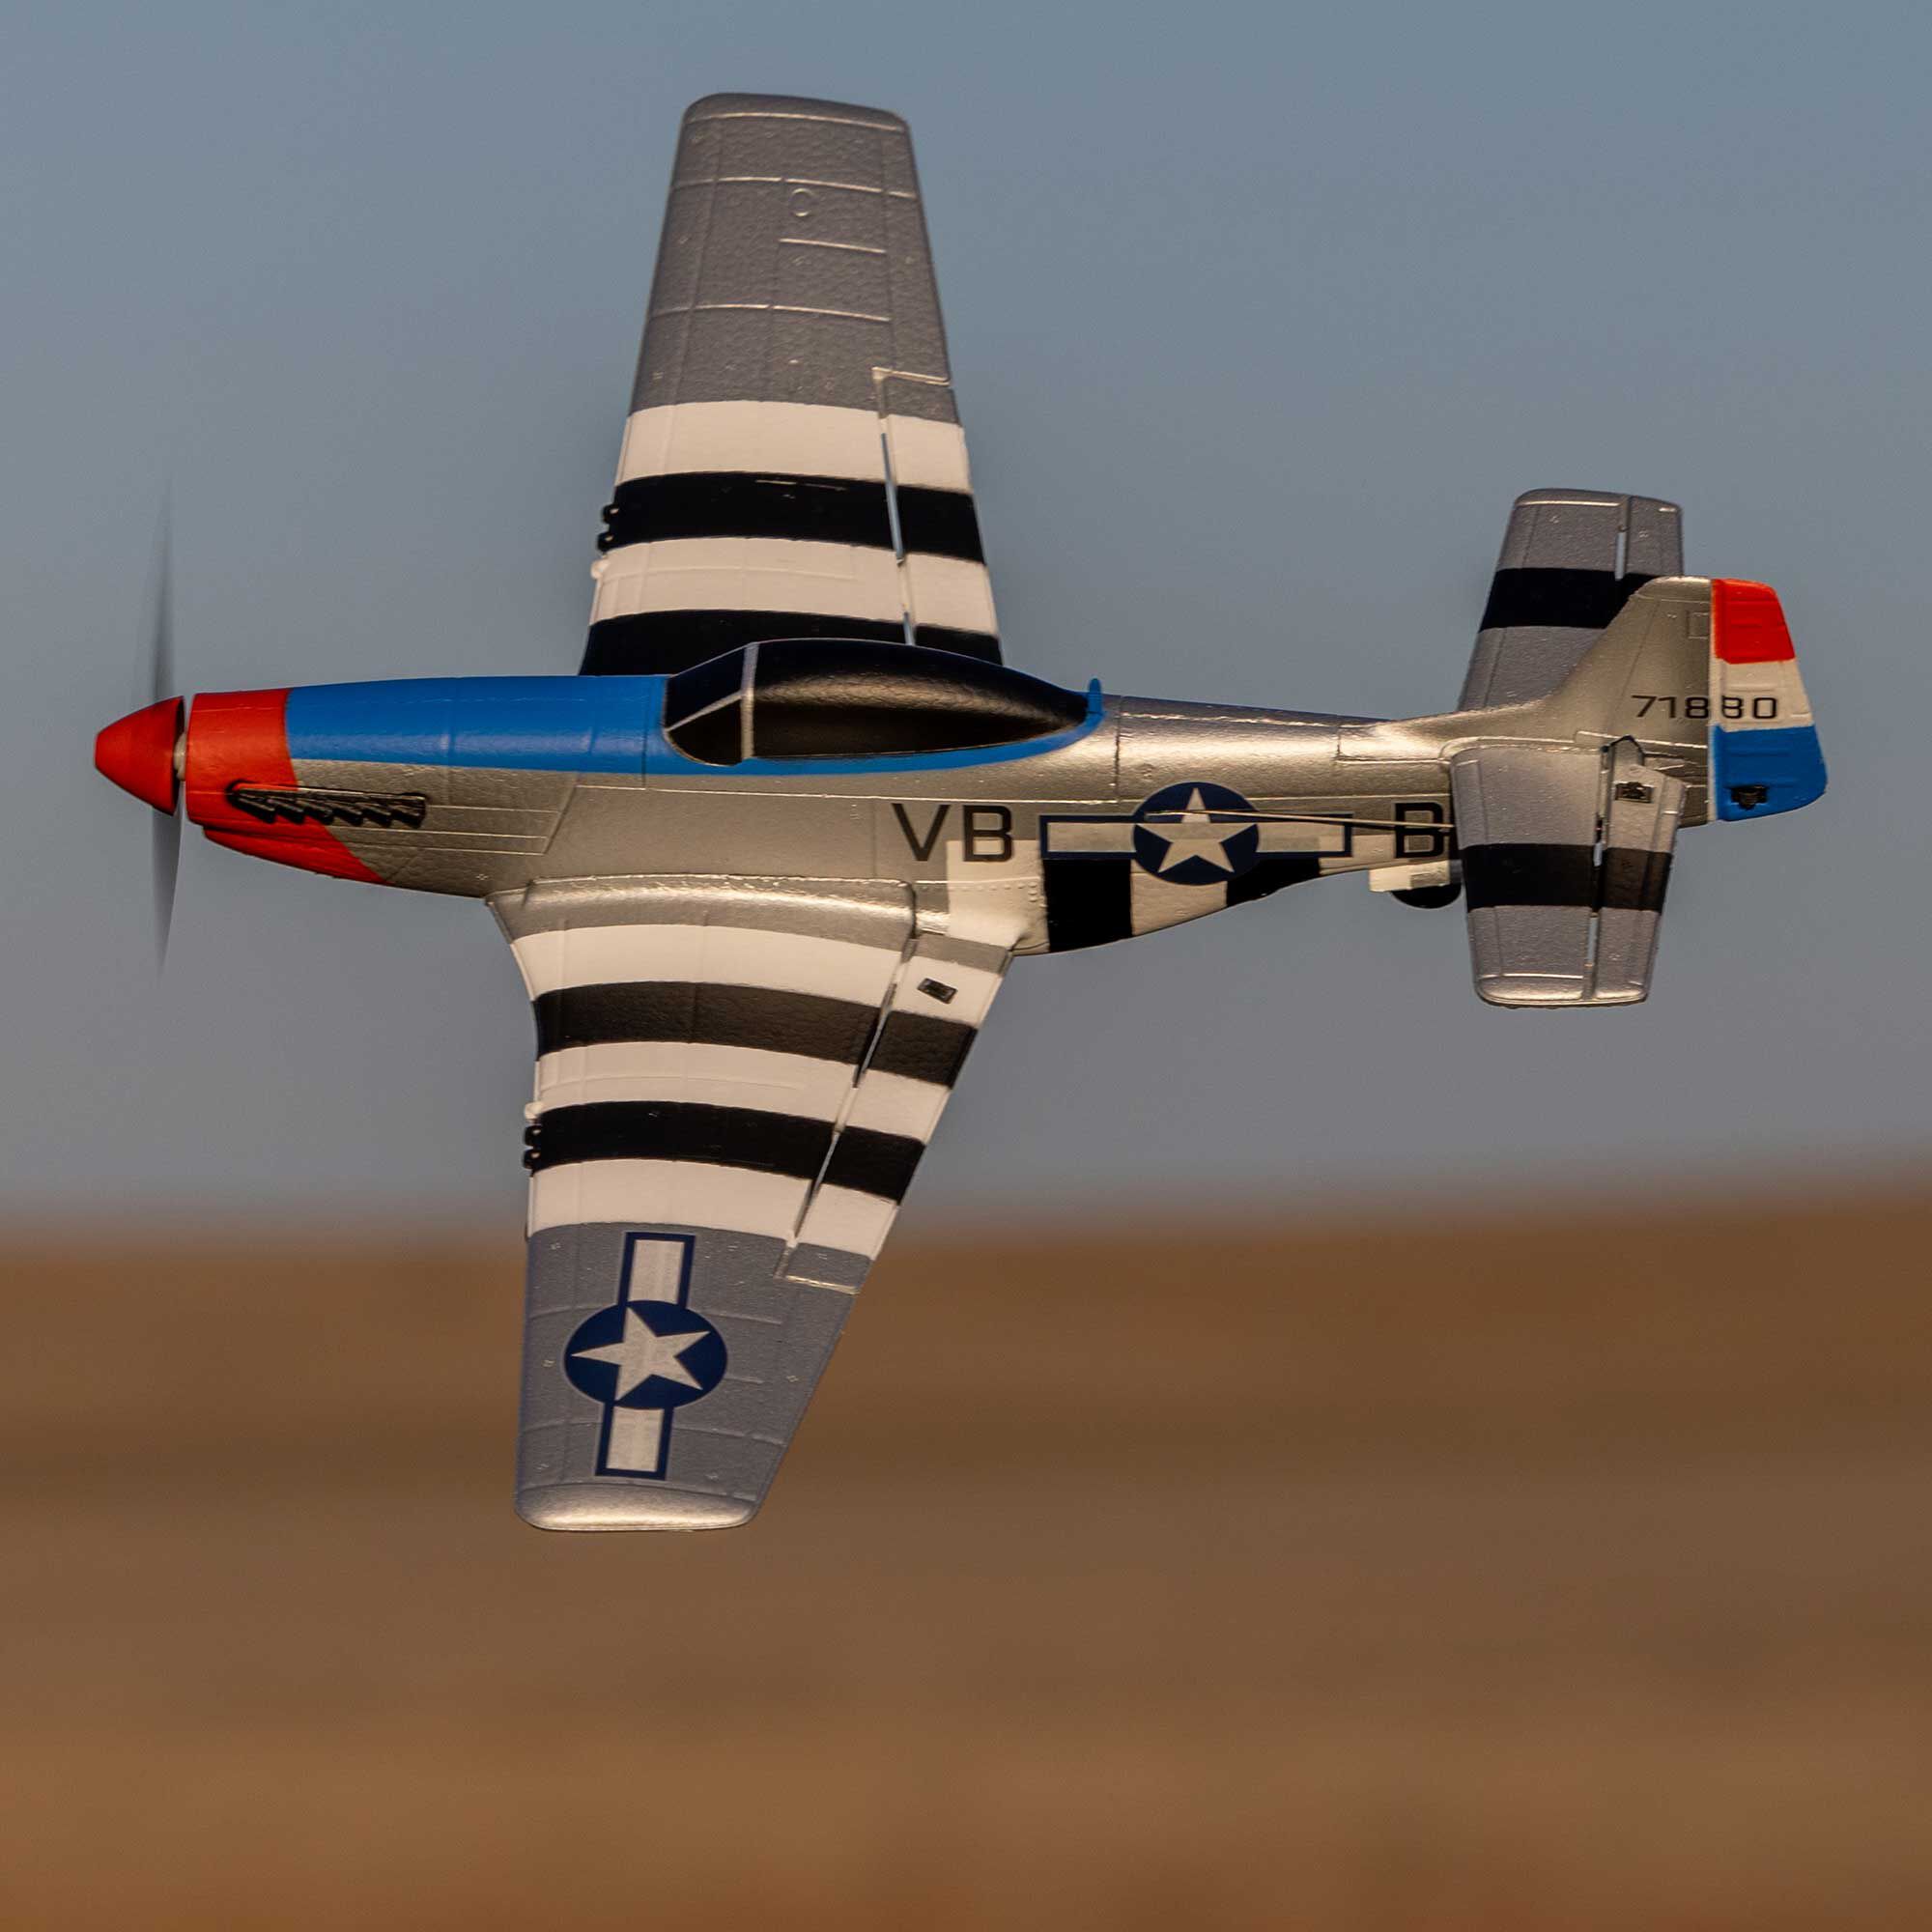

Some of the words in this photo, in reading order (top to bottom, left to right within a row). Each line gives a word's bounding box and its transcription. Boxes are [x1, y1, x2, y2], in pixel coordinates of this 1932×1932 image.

[1631, 695, 1777, 720] 71880
[891, 802, 1012, 863] VB
[1395, 802, 1444, 859] B
